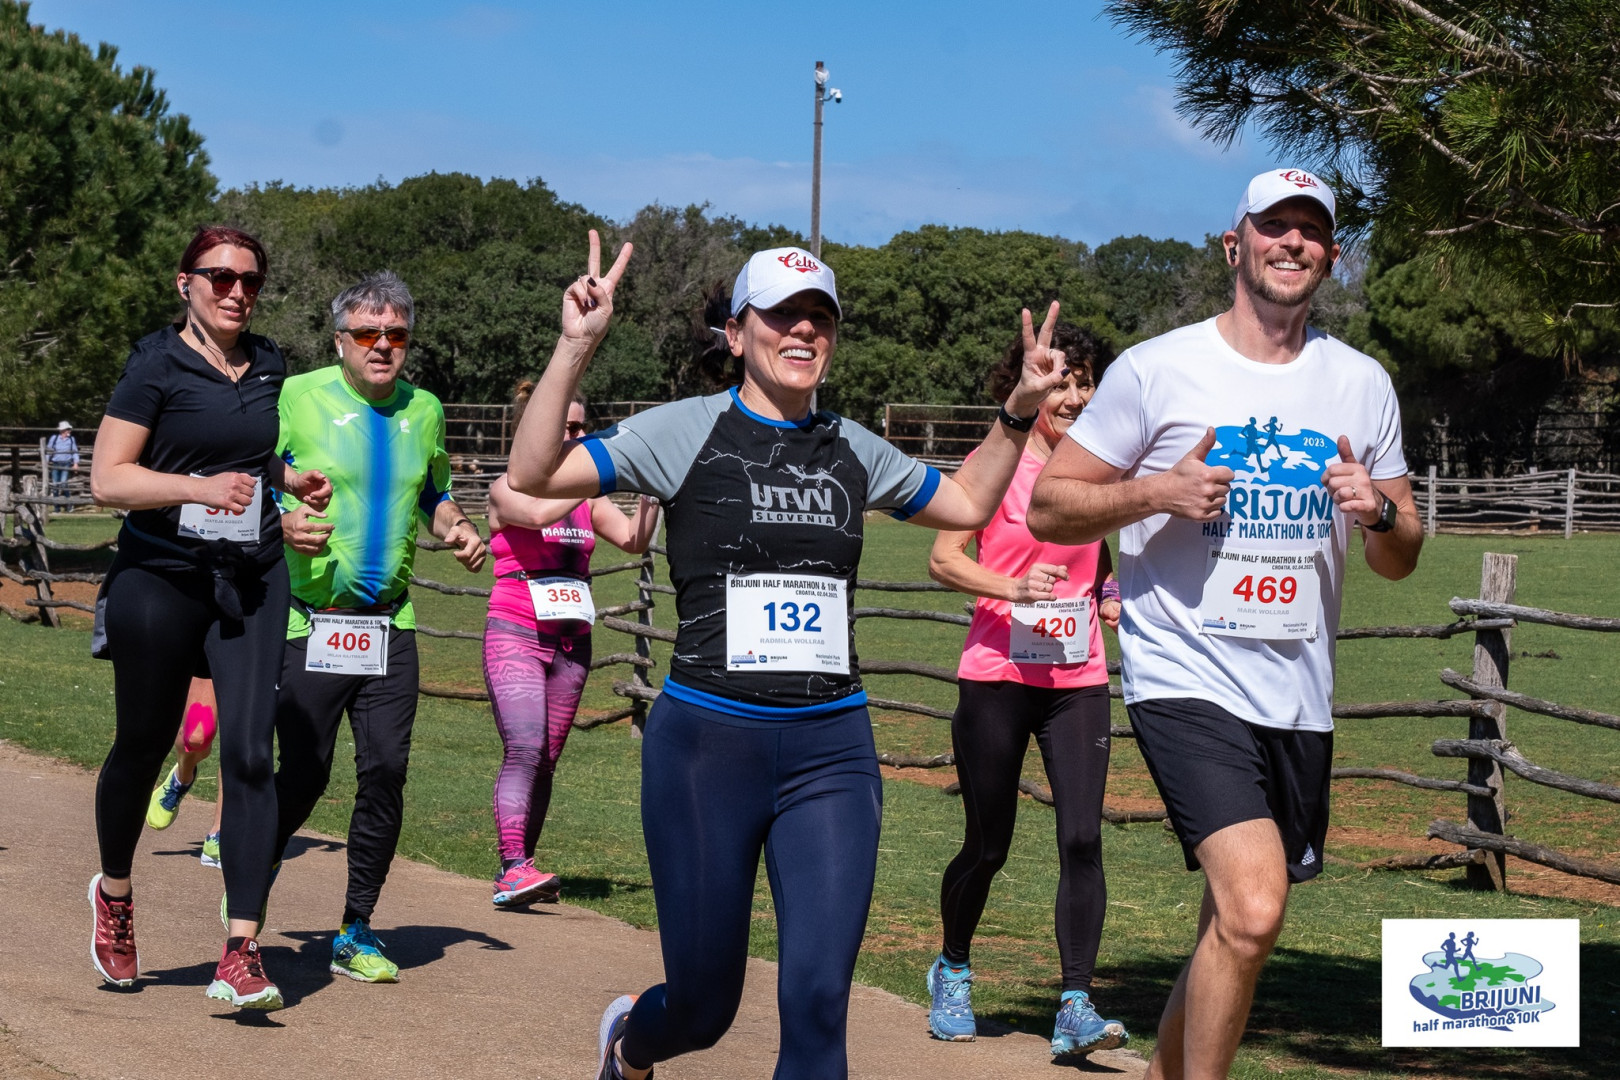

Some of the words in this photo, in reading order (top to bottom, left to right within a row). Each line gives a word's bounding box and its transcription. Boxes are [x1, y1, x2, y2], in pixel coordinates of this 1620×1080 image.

[1303, 436, 1328, 448] 2023.
[1221, 487, 1333, 521] RIJUNI
[756, 511, 833, 525] SLOVENIA
[1202, 521, 1235, 538] HALF
[1239, 522, 1303, 539] MARATHON
[1306, 523, 1315, 539] &
[1317, 523, 1332, 539] 10K
[1211, 550, 1239, 561] BRIJUNI
[1241, 554, 1259, 563] HALF
[1261, 556, 1296, 564] MARATHON
[1297, 556, 1302, 564] &
[1304, 556, 1314, 564] 10K
[730, 579, 760, 588] BRIJUNI
[763, 580, 780, 588] HALF
[783, 580, 820, 590] MARATHON
[828, 583, 838, 592] 10K
[1233, 575, 1297, 604] 469
[547, 588, 582, 603] 358
[764, 602, 822, 632] 132
[1032, 617, 1076, 638] 420
[327, 632, 370, 651] 406
